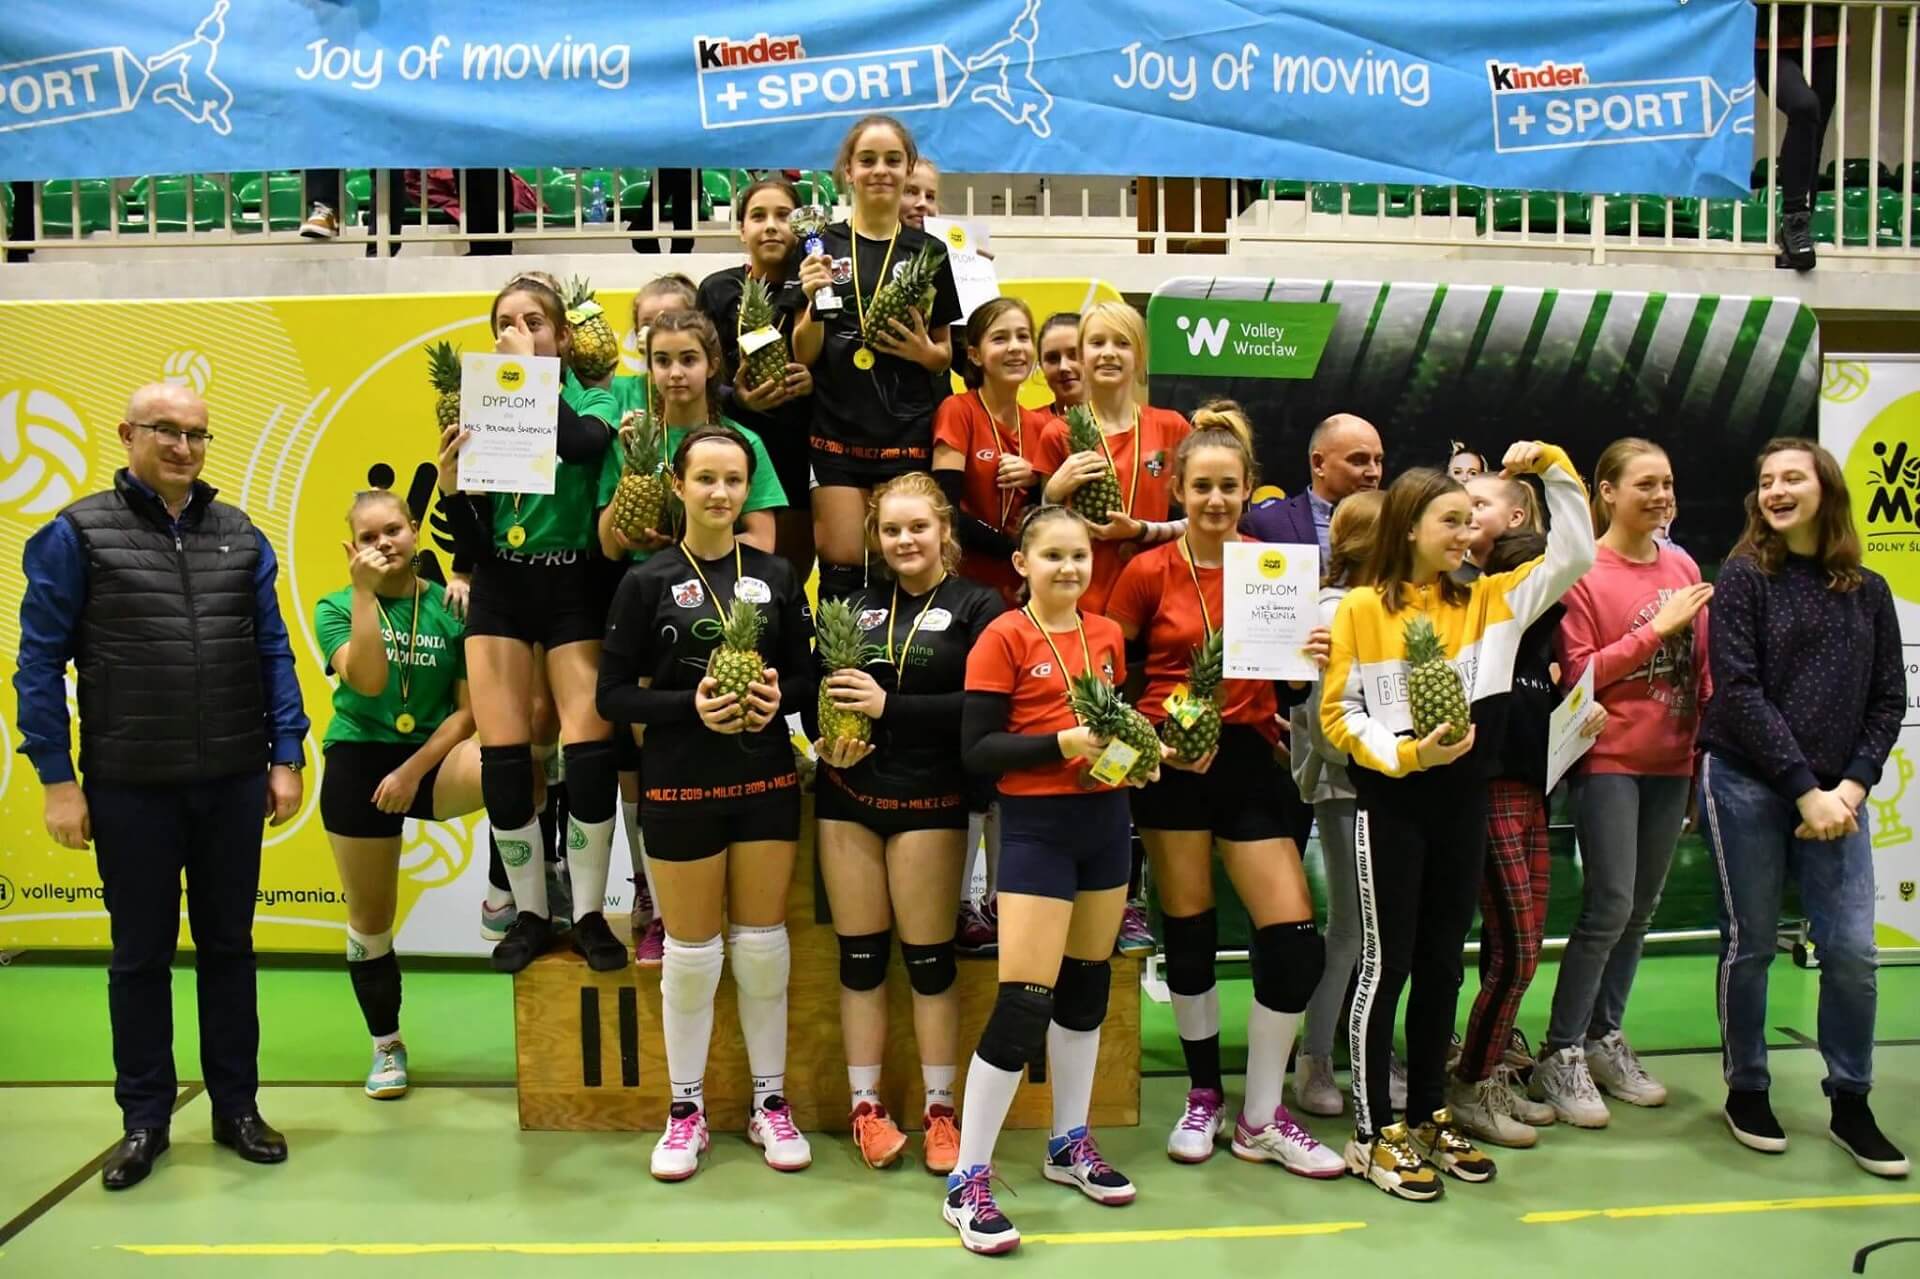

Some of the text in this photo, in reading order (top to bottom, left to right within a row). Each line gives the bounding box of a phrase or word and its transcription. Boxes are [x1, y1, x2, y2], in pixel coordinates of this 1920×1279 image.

[296, 35, 631, 89] Joy of moving
[1113, 42, 1431, 106] Joy of moving
[758, 60, 920, 108] SPORT
[1545, 90, 1690, 134] SPORT
[1240, 323, 1285, 342] Volley
[1233, 341, 1298, 357] Wrocław
[481, 394, 536, 409] DYPLOM
[1867, 541, 1905, 552] DOLNY
[1245, 583, 1298, 596] DYPLOM
[650, 788, 678, 800] MILICZ
[680, 788, 703, 800] 2019
[712, 785, 742, 798] MILICZ
[744, 780, 766, 794] 2019
[876, 798, 899, 809] 2019
[1359, 850, 1369, 884] TODAY
[1362, 888, 1375, 930] FEELING
[1365, 932, 1377, 959] GOOD
[1360, 960, 1376, 990] TODAY
[1352, 993, 1369, 1033] FEELING
[1351, 1034, 1361, 1060] GOOD
